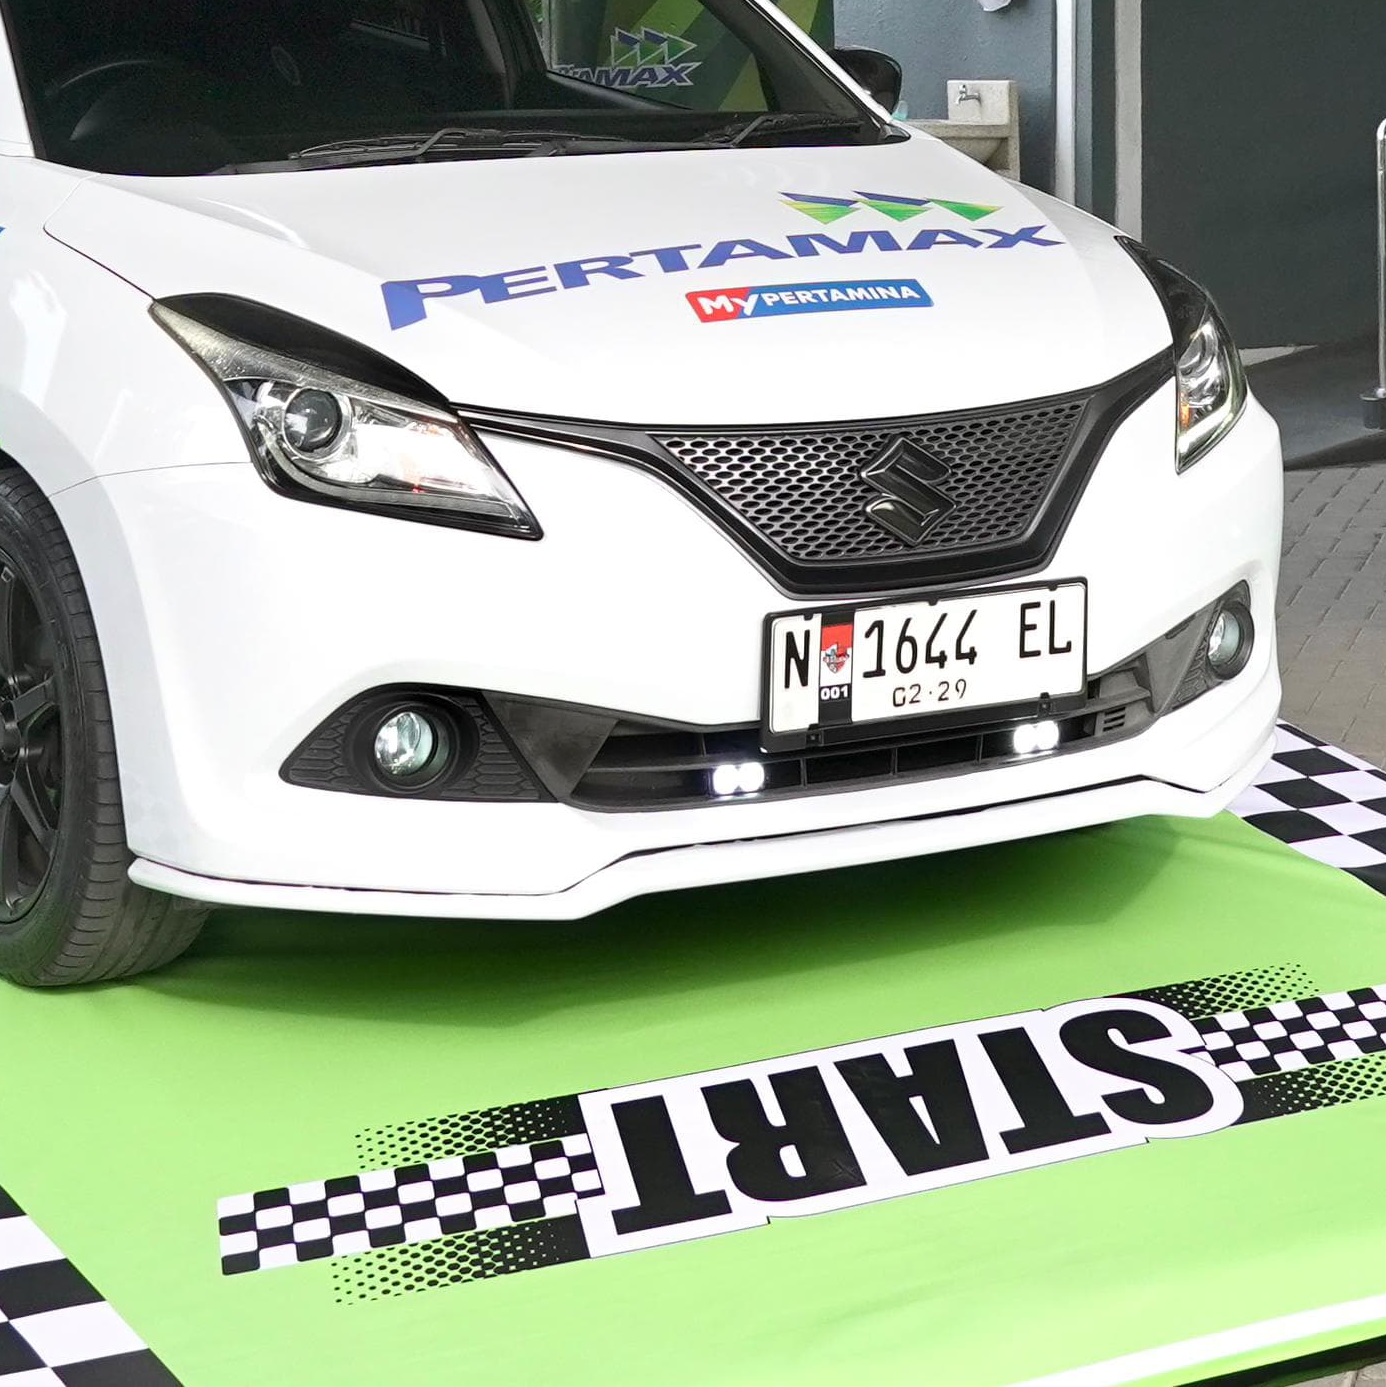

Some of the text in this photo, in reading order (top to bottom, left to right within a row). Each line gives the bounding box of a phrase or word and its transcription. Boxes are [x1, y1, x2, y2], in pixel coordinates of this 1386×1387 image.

[380, 223, 1065, 331] PERTAMAX
[783, 599, 1073, 690] N 1644 EL
[820, 684, 849, 701] 001
[610, 1008, 1218, 1235] START
